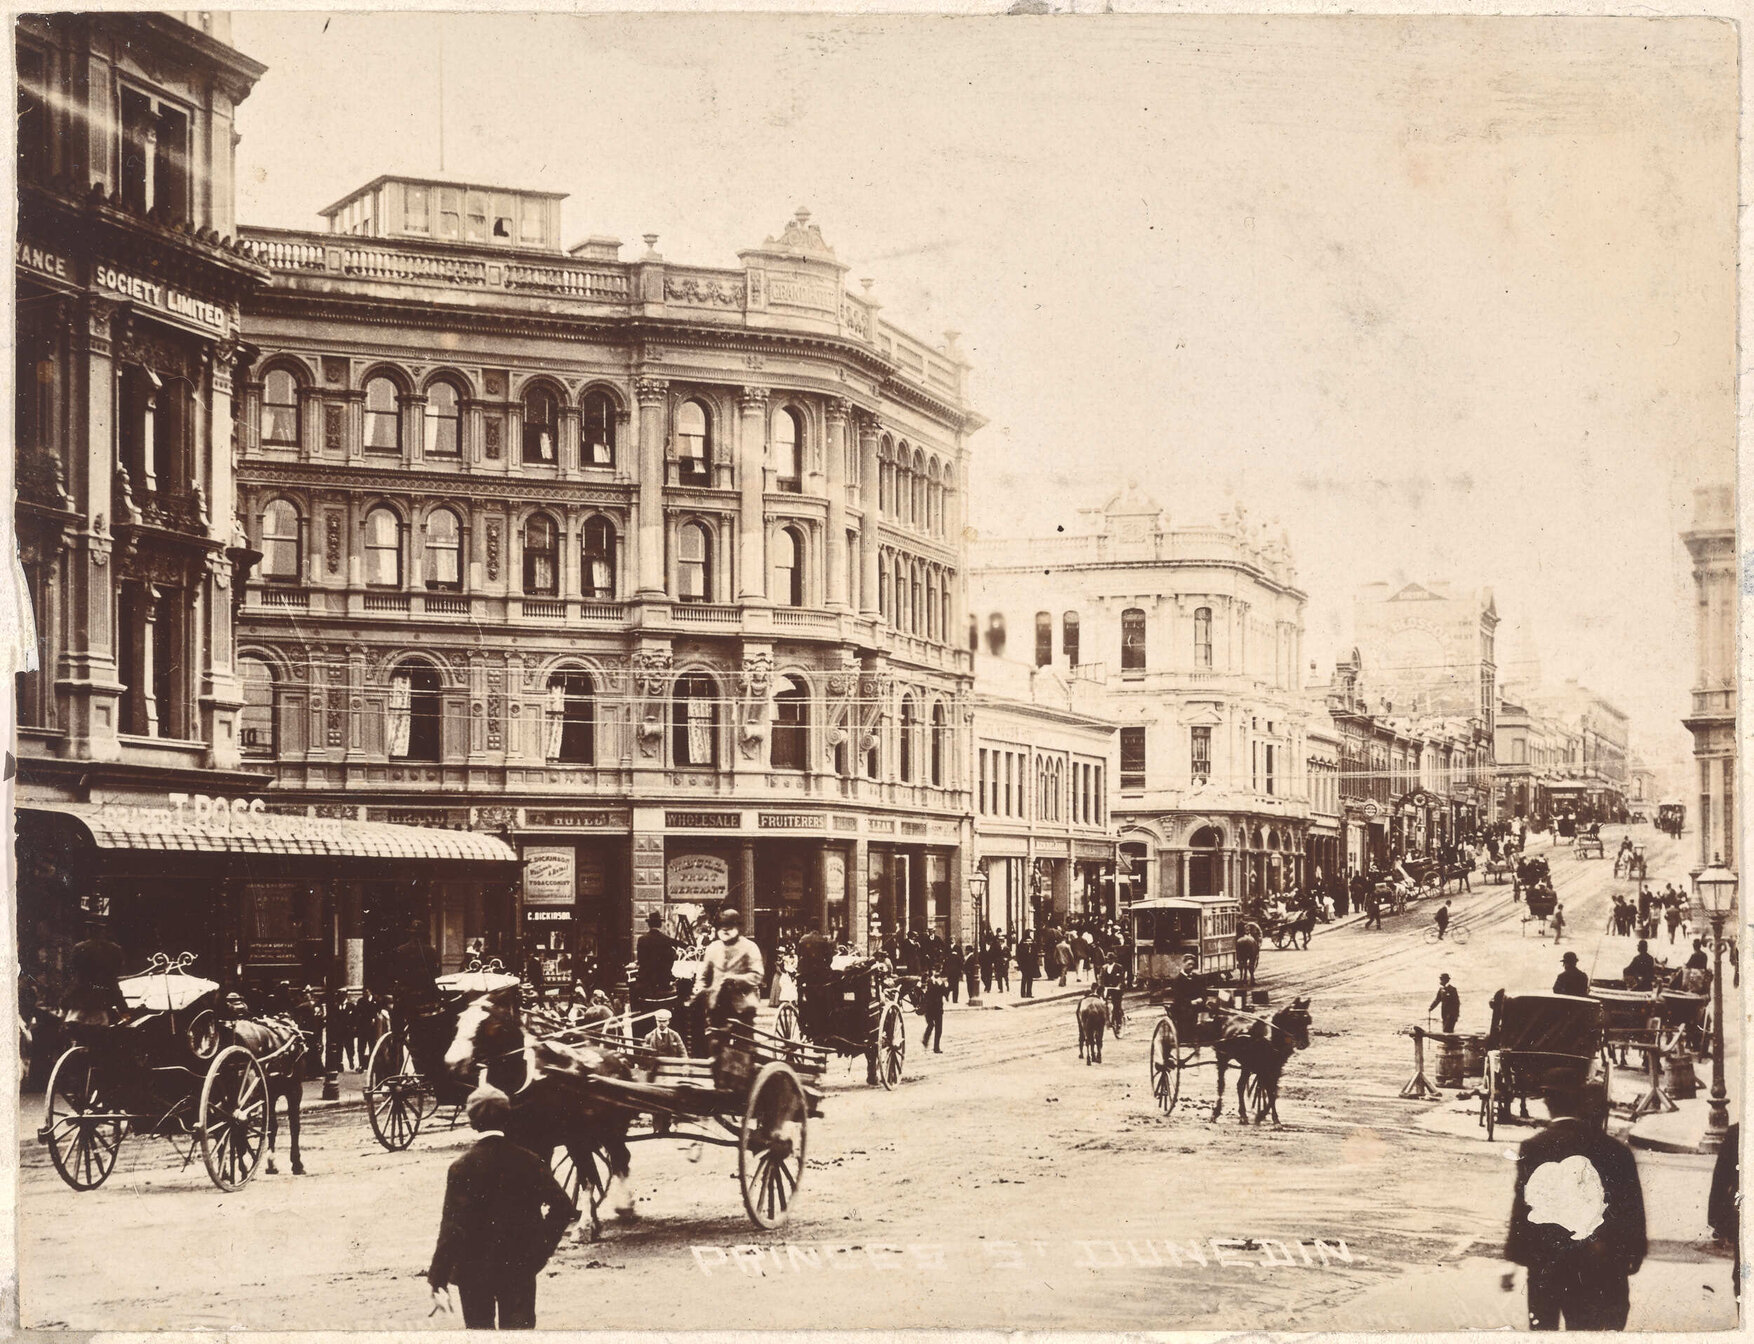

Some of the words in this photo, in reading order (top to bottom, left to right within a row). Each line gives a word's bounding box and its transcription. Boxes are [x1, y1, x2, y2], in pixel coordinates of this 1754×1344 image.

[97, 265, 161, 306] SOCIETY
[167, 290, 225, 326] LIMITED
[666, 813, 739, 827] WHOLESALE
[760, 815, 824, 828] FRUITERERS
